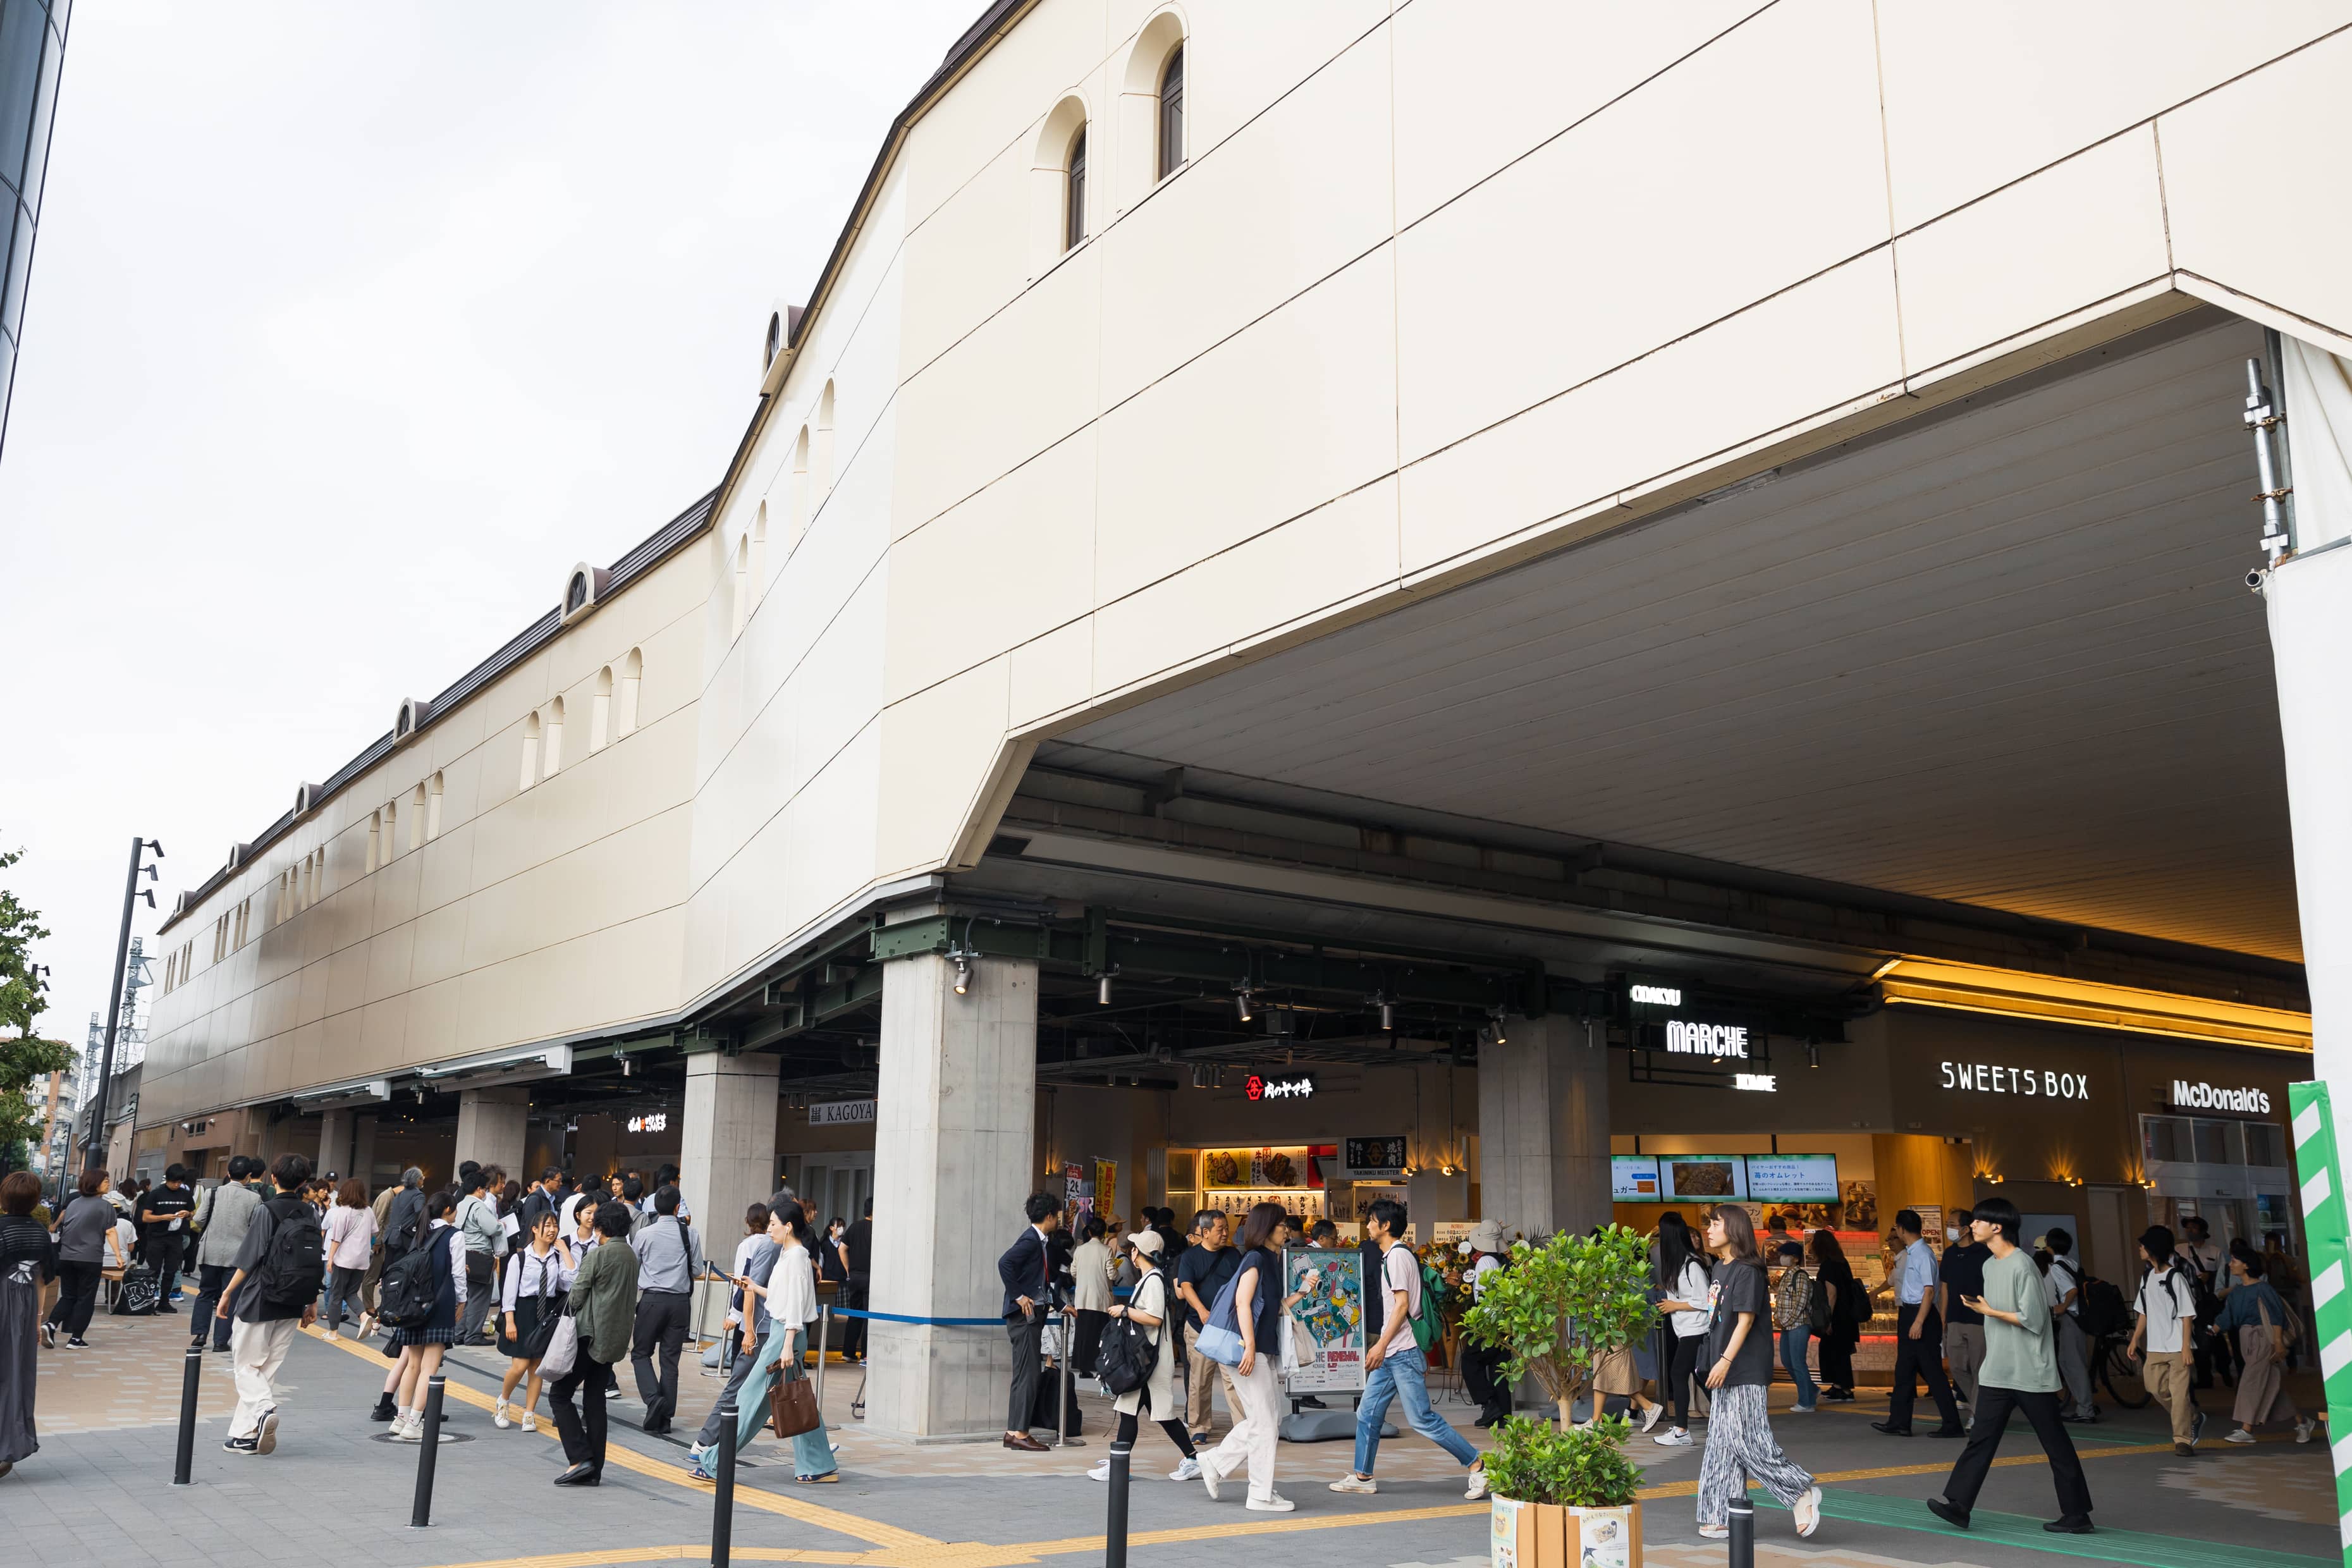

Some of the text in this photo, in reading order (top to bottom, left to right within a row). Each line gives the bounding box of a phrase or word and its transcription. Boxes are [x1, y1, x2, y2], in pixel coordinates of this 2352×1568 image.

[1631, 985, 1681, 1006] ODAKYU
[1667, 1020, 1748, 1058] MARCHE
[1265, 1078, 1313, 1099] 肉のヤマ牛
[1941, 1062, 2089, 1099] SWEETS BOX
[2173, 1079, 2270, 1114] McDonald's
[827, 1103, 873, 1122] KAGOYA
[1327, 1351, 1360, 1362] RENEWAL
